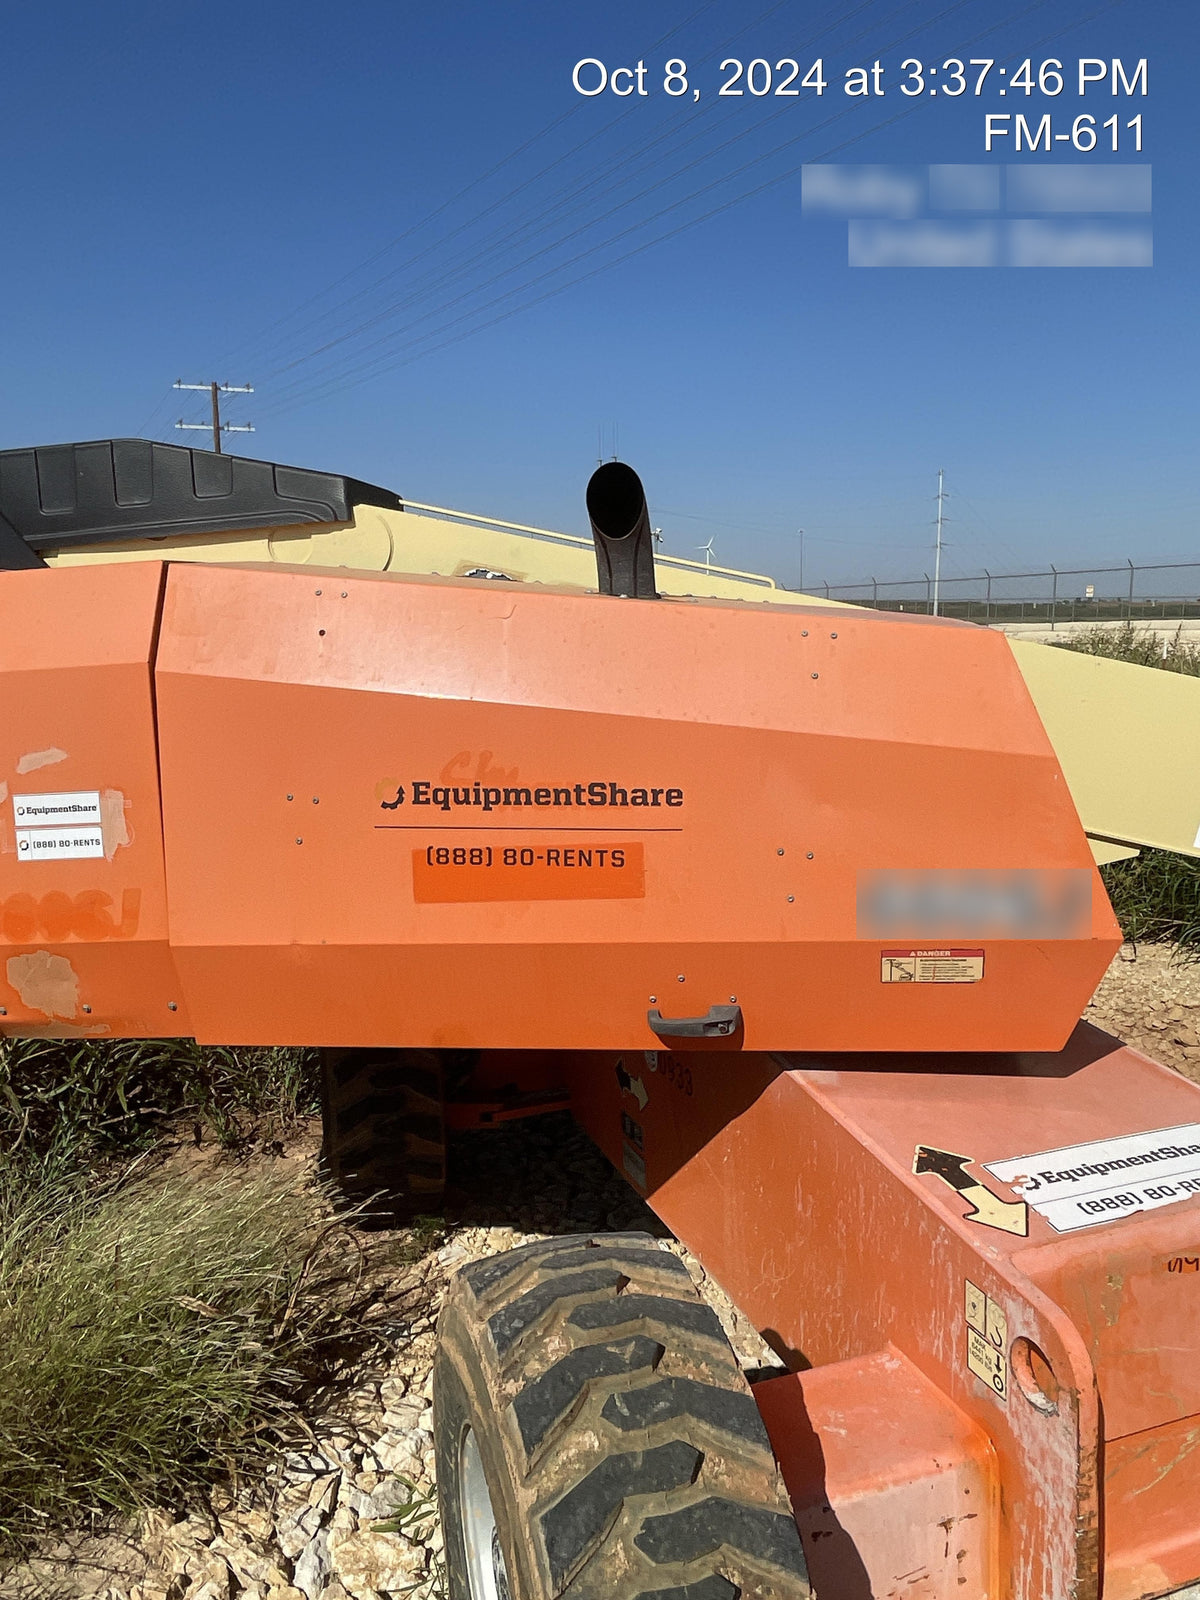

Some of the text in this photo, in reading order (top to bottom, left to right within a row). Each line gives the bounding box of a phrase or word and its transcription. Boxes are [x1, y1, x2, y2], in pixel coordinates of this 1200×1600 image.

[412, 781, 683, 811] EquipmentShare
[26, 804, 97, 816] EquipmentShare
[426, 846, 625, 868] (888) 80-RENTS
[1077, 1191, 1143, 1216] (888)
